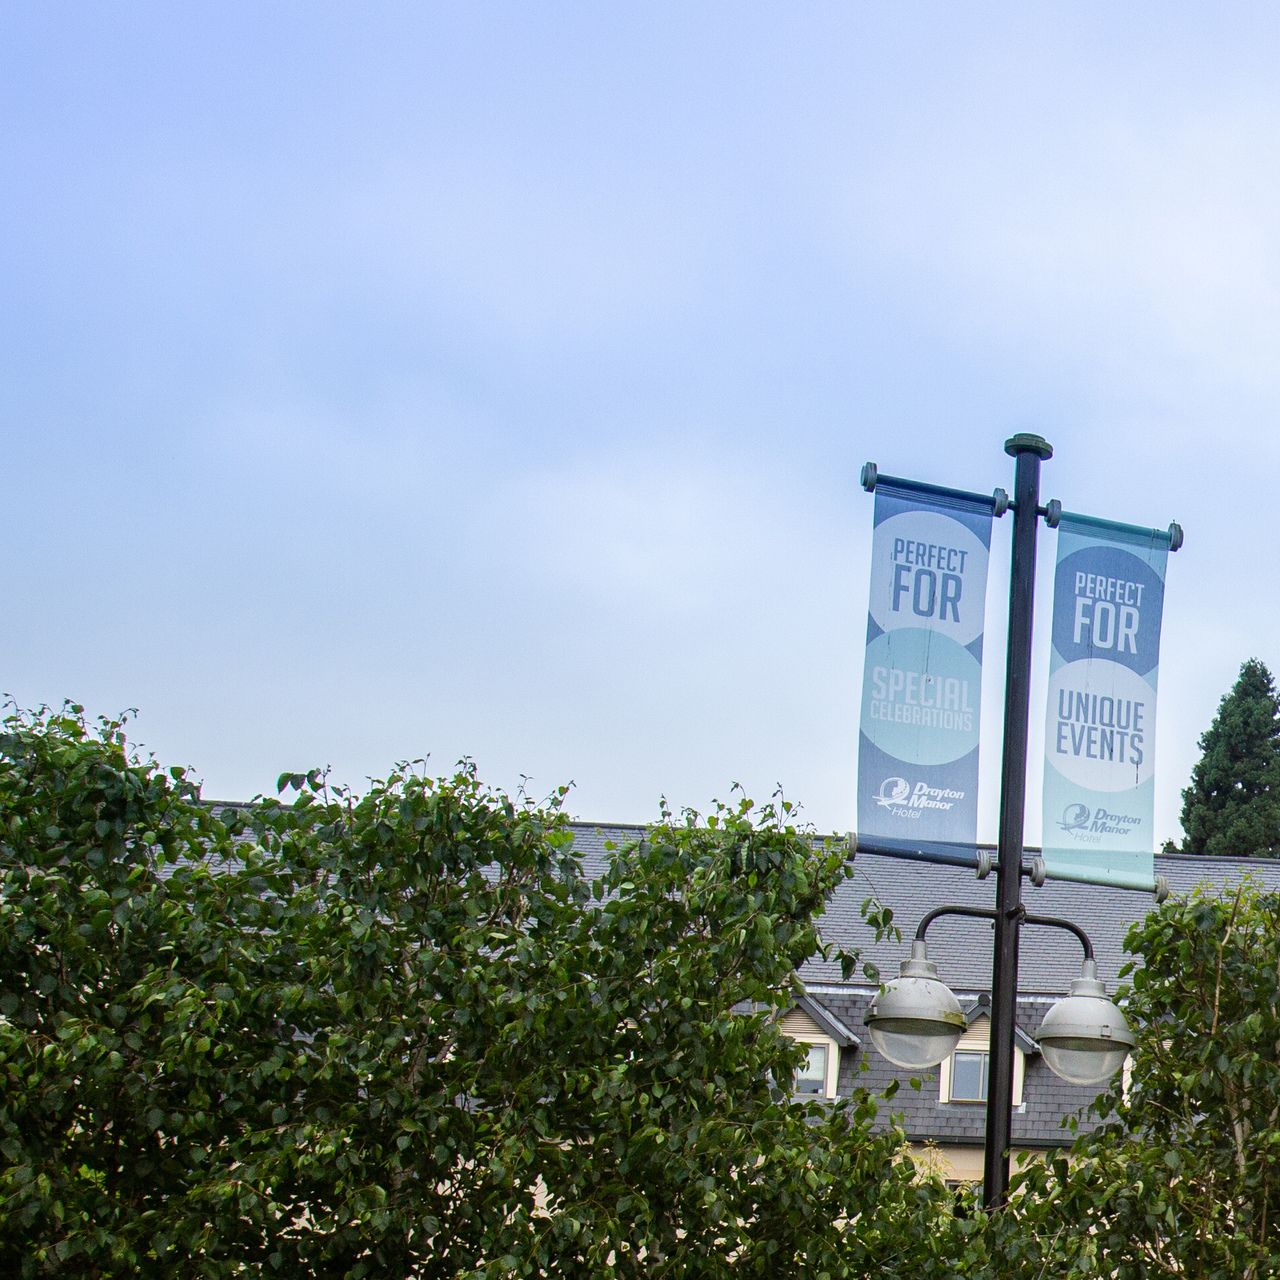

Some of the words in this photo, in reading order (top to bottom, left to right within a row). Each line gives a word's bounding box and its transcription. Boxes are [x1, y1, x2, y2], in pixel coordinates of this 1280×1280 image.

[893, 537, 969, 575] PERFECT
[892, 562, 963, 623] FOR
[1074, 571, 1145, 607] PERFECT
[1073, 596, 1141, 655] FOR
[871, 665, 974, 713] SPECIAL
[869, 699, 973, 732] CELEBRATIONS
[1058, 688, 1145, 733] UNIQUE
[1056, 721, 1144, 766] EVENTS
[907, 794, 954, 811] Manor
[913, 781, 965, 801] Drayton
[891, 806, 922, 820] Hotel
[1089, 819, 1132, 836] Manor
[1093, 808, 1142, 827] Drayton
[1073, 831, 1102, 844] Hotel
